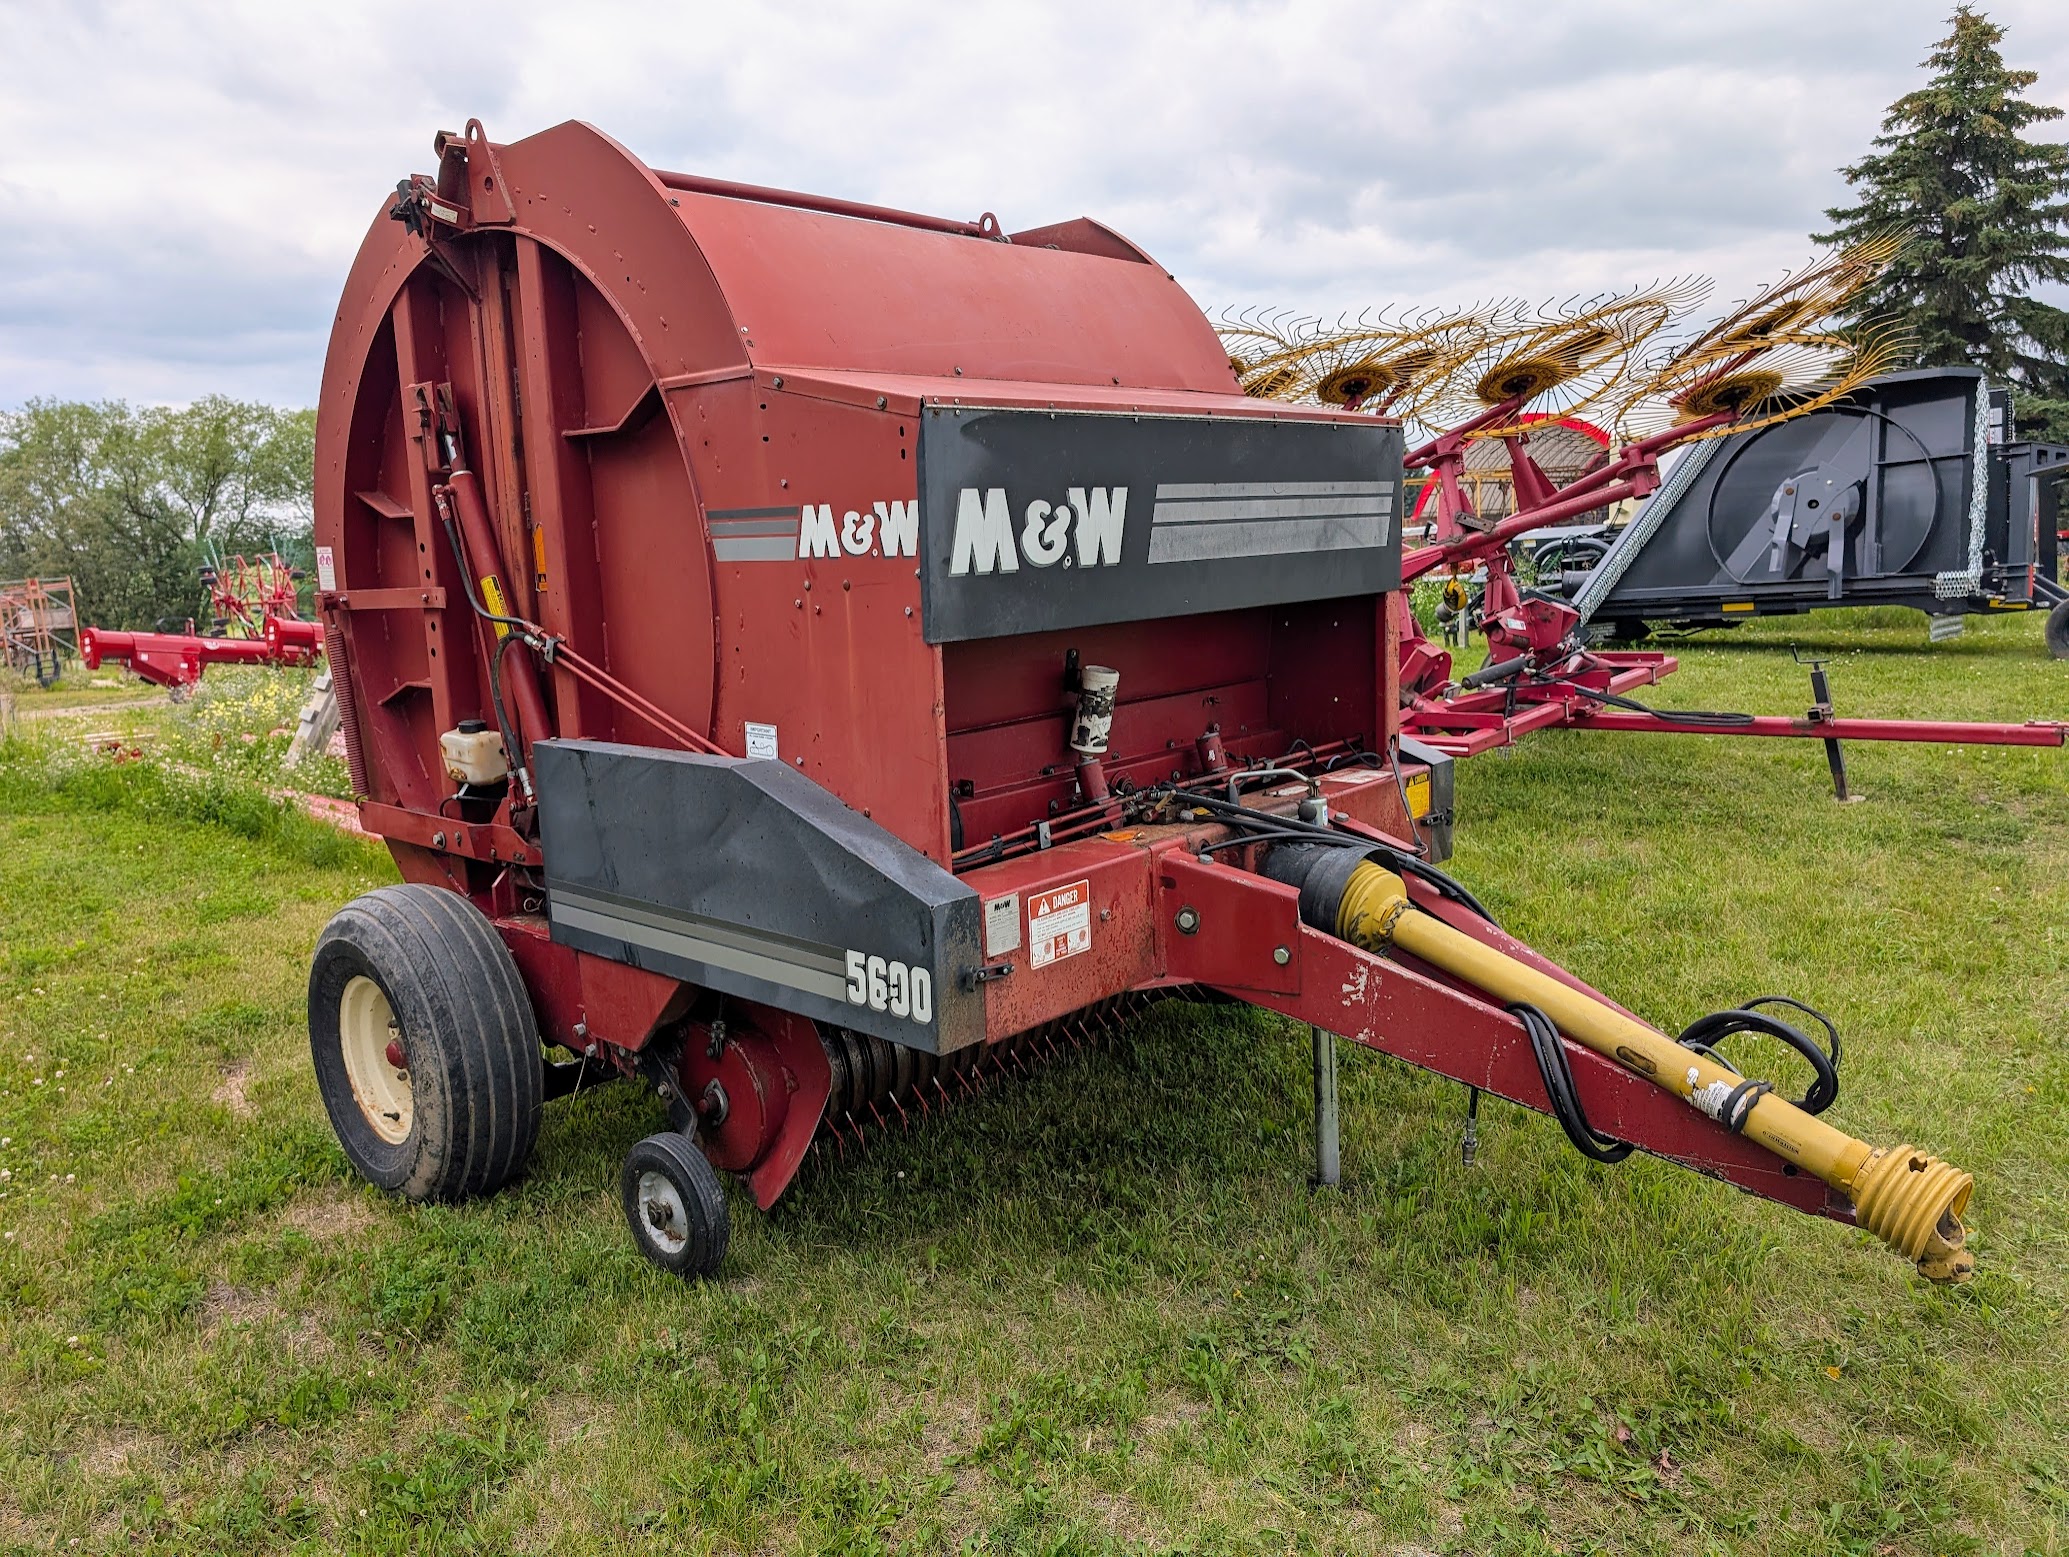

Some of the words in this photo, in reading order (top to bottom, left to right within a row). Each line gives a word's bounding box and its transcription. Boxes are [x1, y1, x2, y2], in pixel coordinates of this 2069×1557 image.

[798, 499, 919, 559] M&W
[949, 486, 1128, 577] M&W
[1052, 889, 1079, 910] DANGER
[845, 949, 932, 1025] 5600
